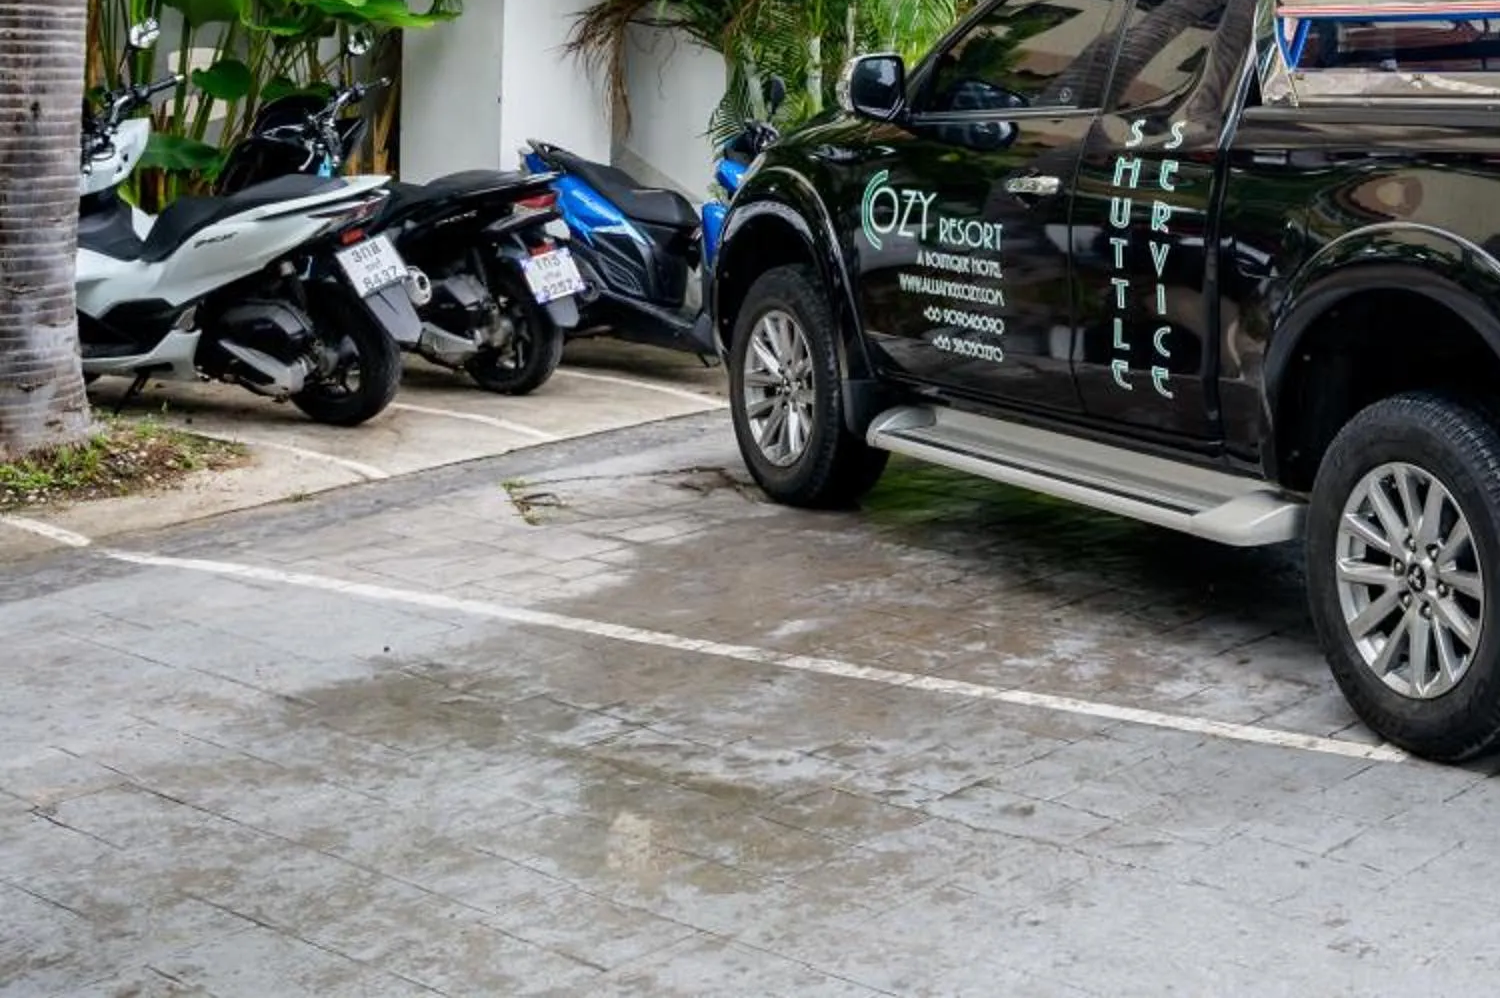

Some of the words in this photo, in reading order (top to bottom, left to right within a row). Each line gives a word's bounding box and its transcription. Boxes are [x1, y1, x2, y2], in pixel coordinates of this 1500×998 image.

[861, 169, 938, 251] COZY
[938, 216, 1003, 251] RESORT
[1109, 119, 1147, 391] SHUTTLE
[1149, 120, 1187, 399] SERVICE
